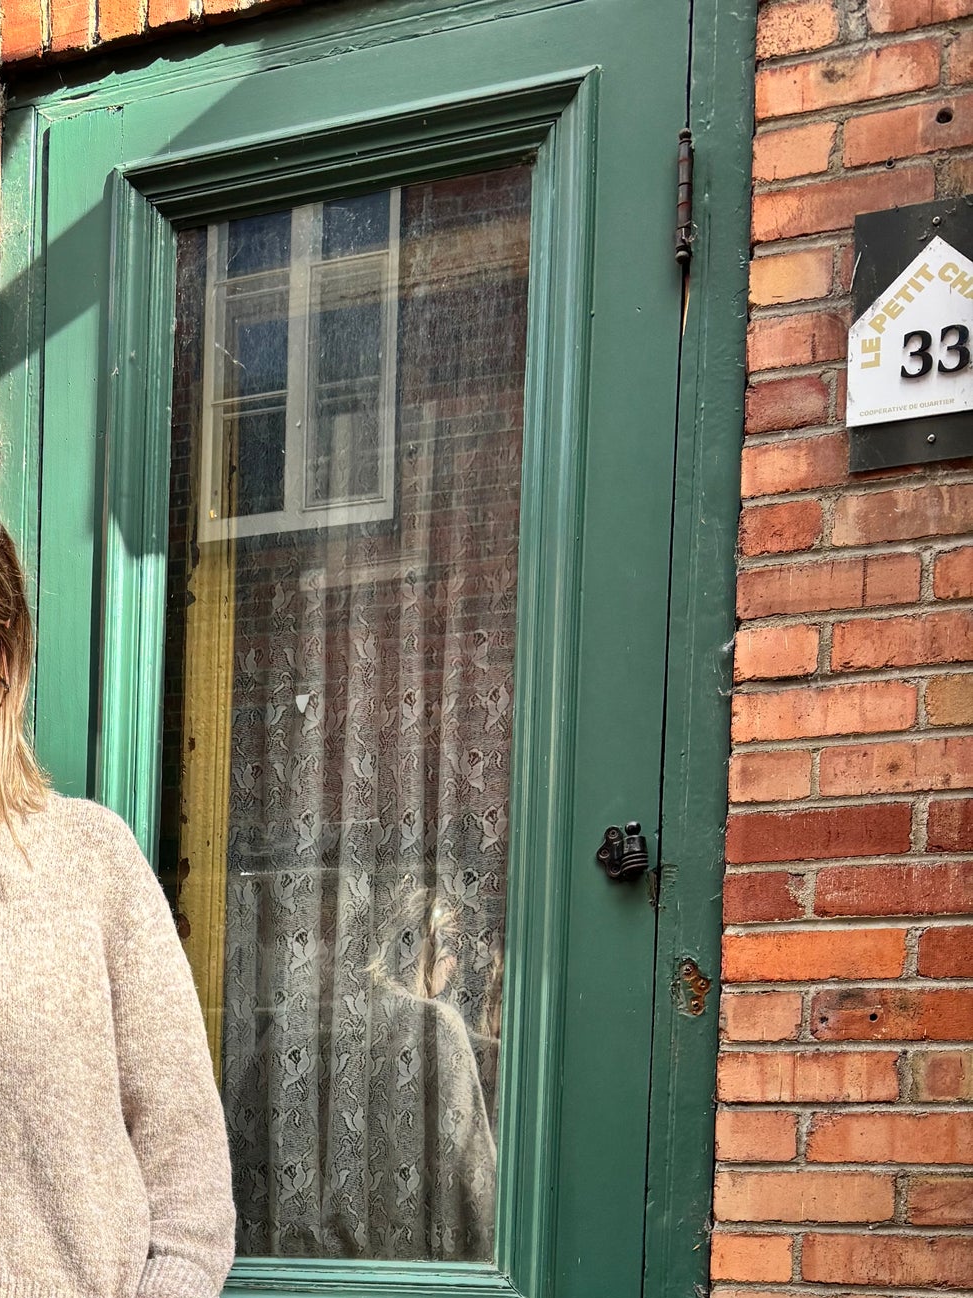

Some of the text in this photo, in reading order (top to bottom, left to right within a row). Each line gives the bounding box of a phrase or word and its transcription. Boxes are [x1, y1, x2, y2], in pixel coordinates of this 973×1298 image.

[869, 263, 935, 334] PETIT
[861, 337, 881, 369] LE
[900, 324, 970, 378] 33
[908, 403, 918, 411] DE
[919, 398, 955, 409] QUARTIER
